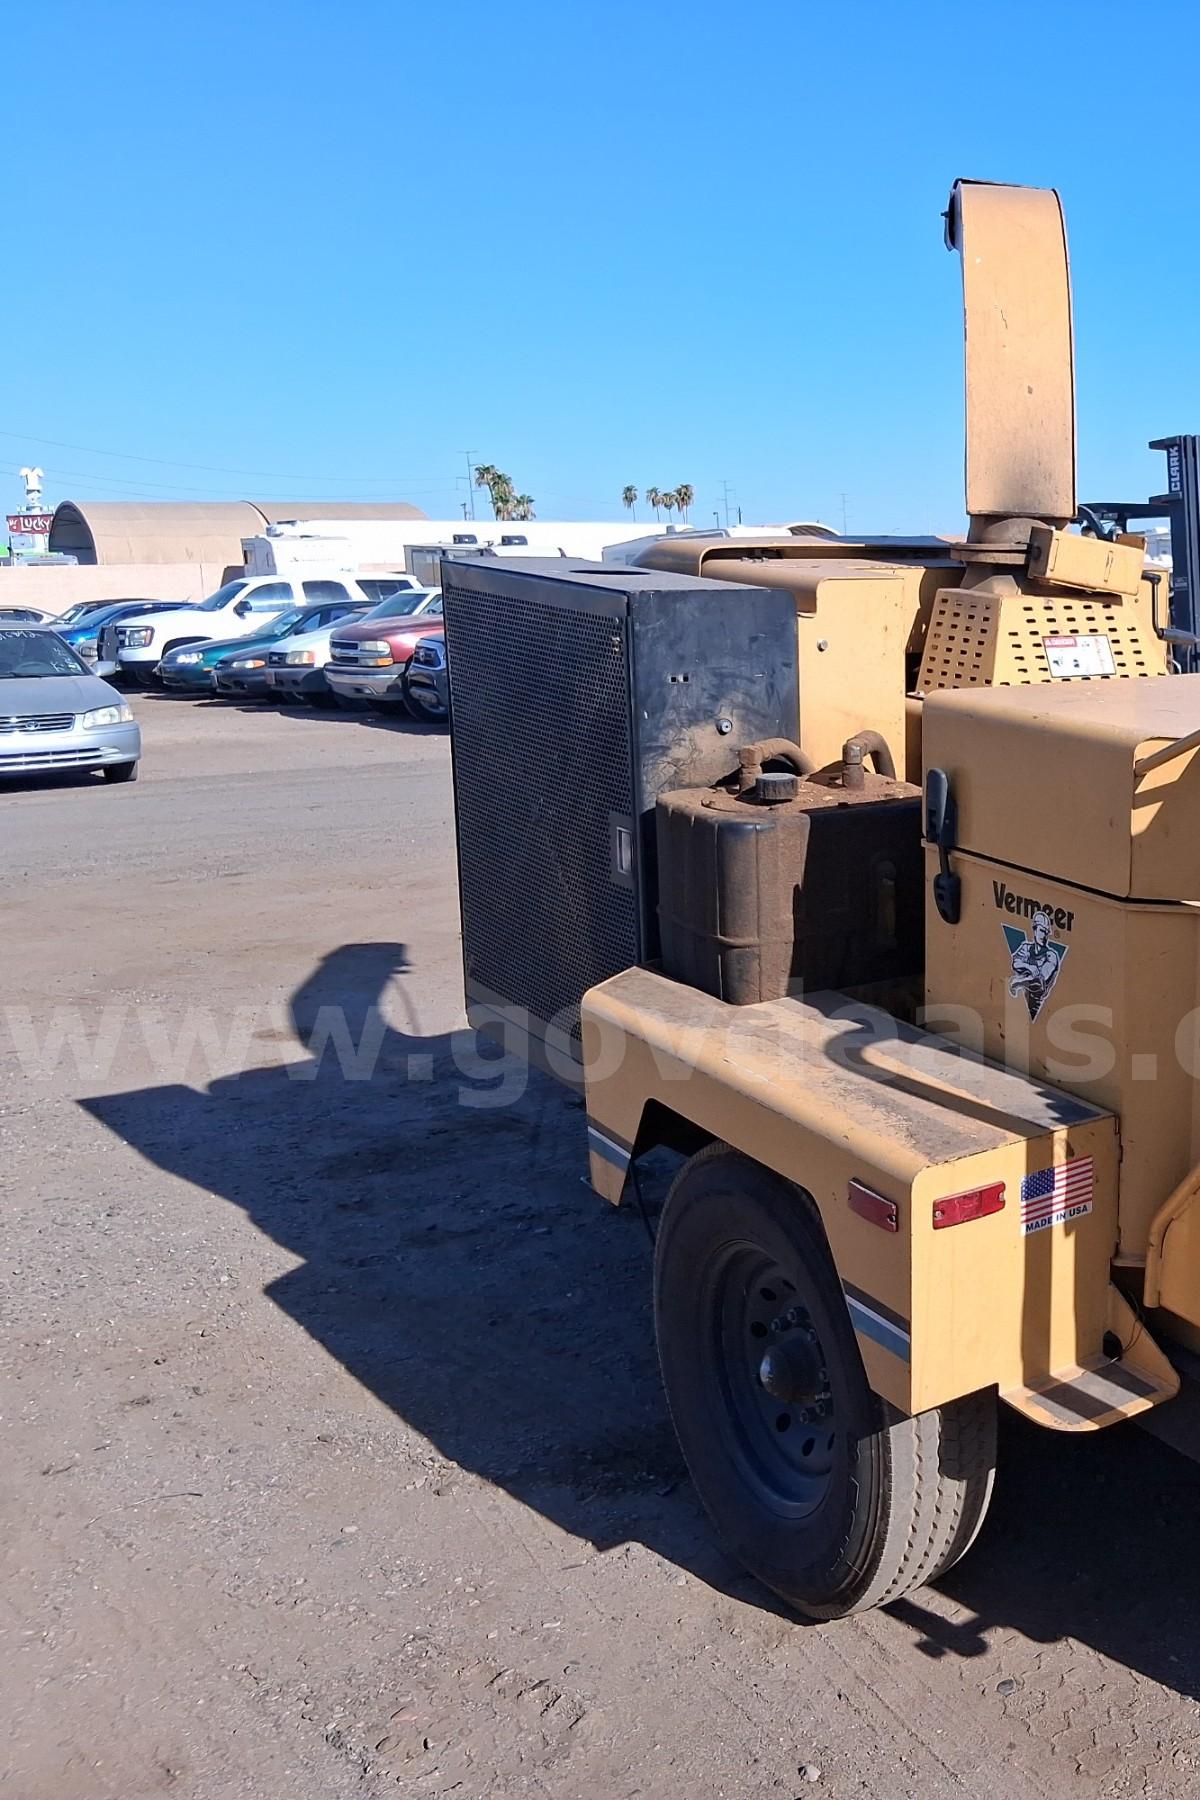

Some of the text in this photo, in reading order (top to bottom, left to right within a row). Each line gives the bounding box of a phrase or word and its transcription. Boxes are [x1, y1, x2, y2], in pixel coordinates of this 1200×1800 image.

[1169, 446, 1180, 492] CLARK
[993, 880, 1075, 932] Vermeer
[1025, 1204, 1088, 1232] MADE IN USA
